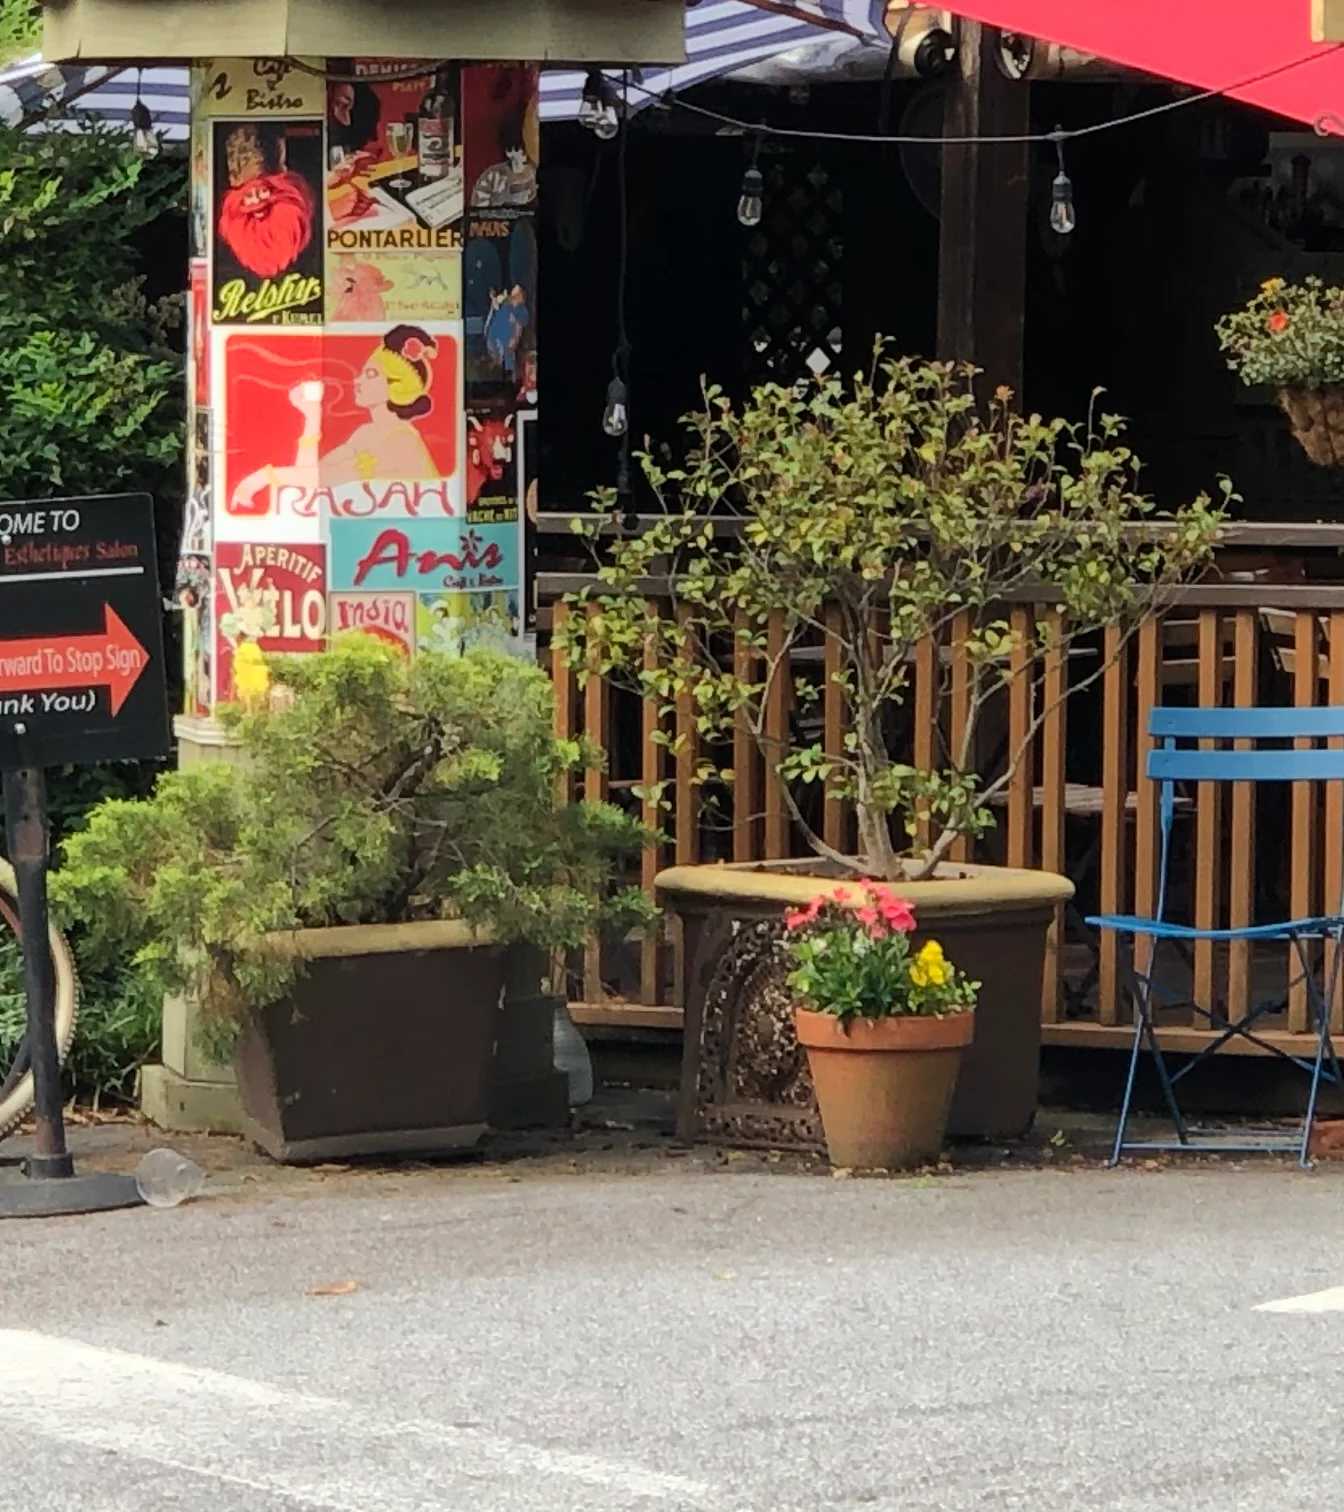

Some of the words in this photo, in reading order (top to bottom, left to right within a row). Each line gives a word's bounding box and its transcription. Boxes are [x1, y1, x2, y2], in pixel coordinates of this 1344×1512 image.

[245, 88, 303, 110] Bistro
[327, 230, 463, 248] PONTARLIER
[275, 482, 454, 517] RAJAH
[50, 509, 80, 531] TO
[96, 540, 138, 560] Salon
[355, 529, 504, 585] Anis
[47, 649, 64, 673] To
[66, 649, 102, 677] Stop
[106, 645, 141, 677] Sign
[40, 690, 96, 713] You)
